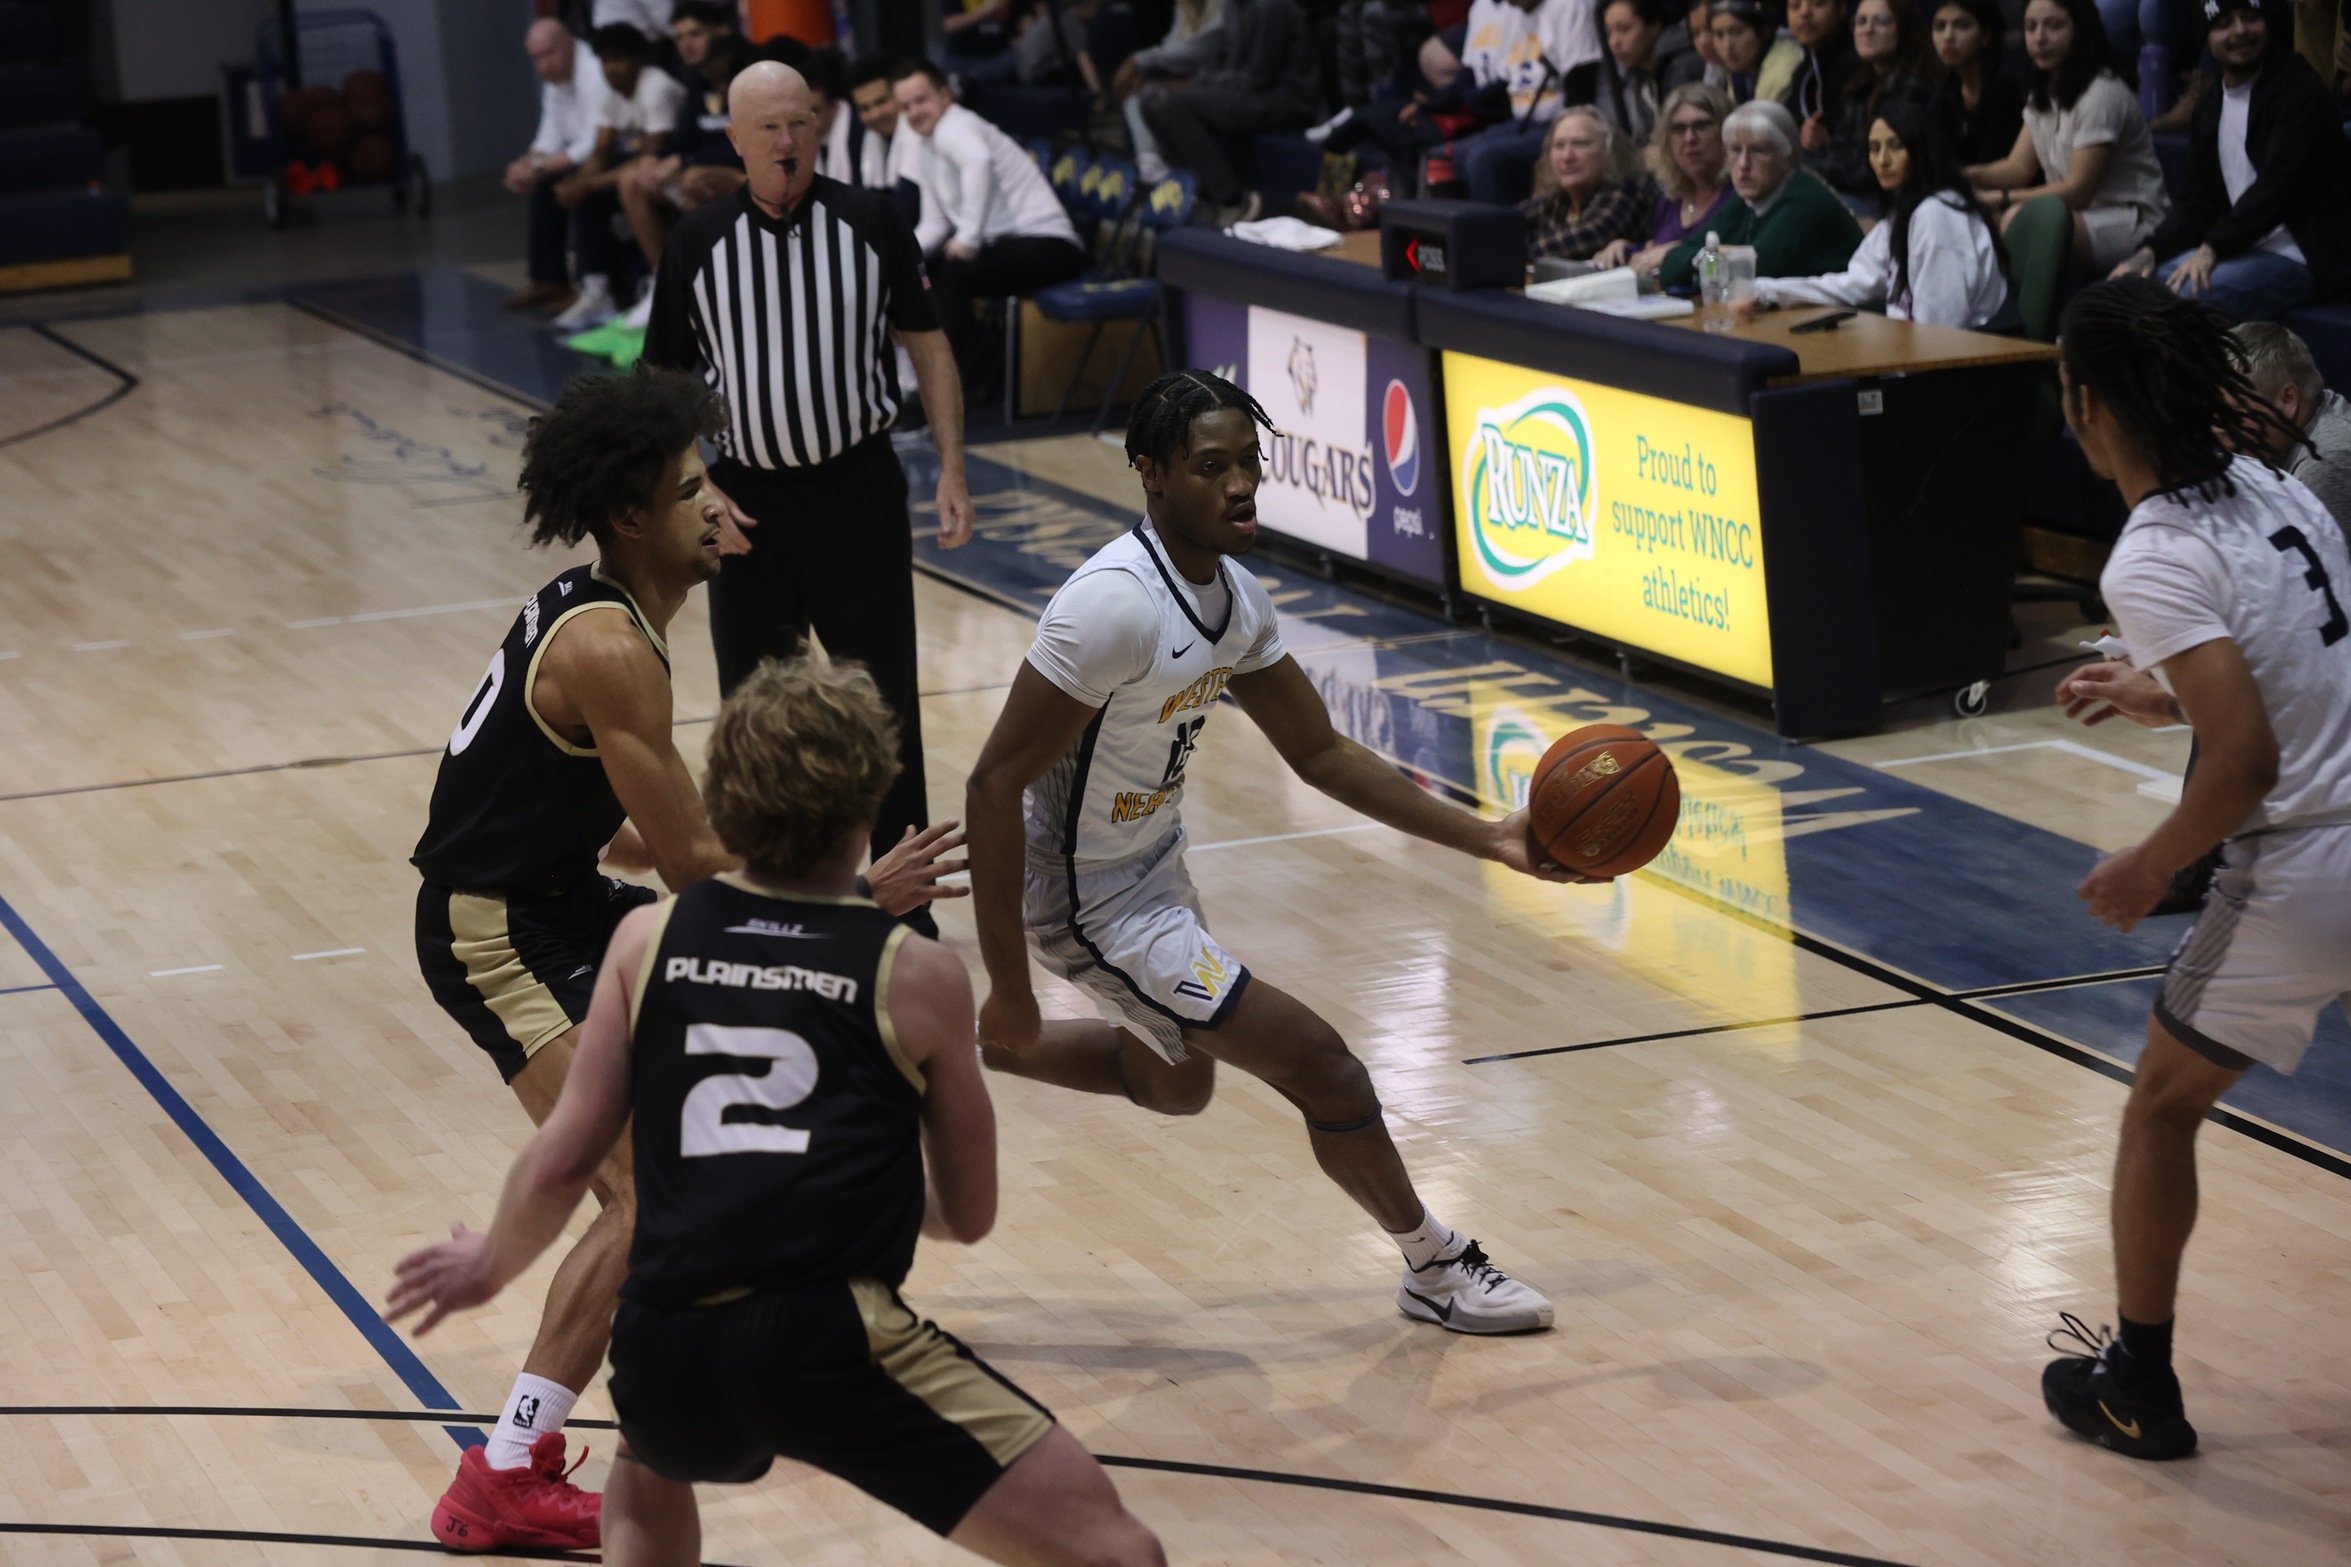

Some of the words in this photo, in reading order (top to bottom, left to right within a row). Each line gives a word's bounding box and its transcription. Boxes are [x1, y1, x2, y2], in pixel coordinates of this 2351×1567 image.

[1260, 435, 1375, 521] OUGARS
[1482, 423, 1589, 545] RUNZA
[1636, 434, 1693, 491] Proud
[1698, 453, 1717, 496] to
[1612, 500, 1685, 554] support
[1688, 510, 1754, 569] WNCC
[1643, 566, 1731, 632] athletics!
[2268, 525, 2348, 646] 3
[665, 956, 859, 1005] PLAINSMEN
[680, 1022, 821, 1159] 2
